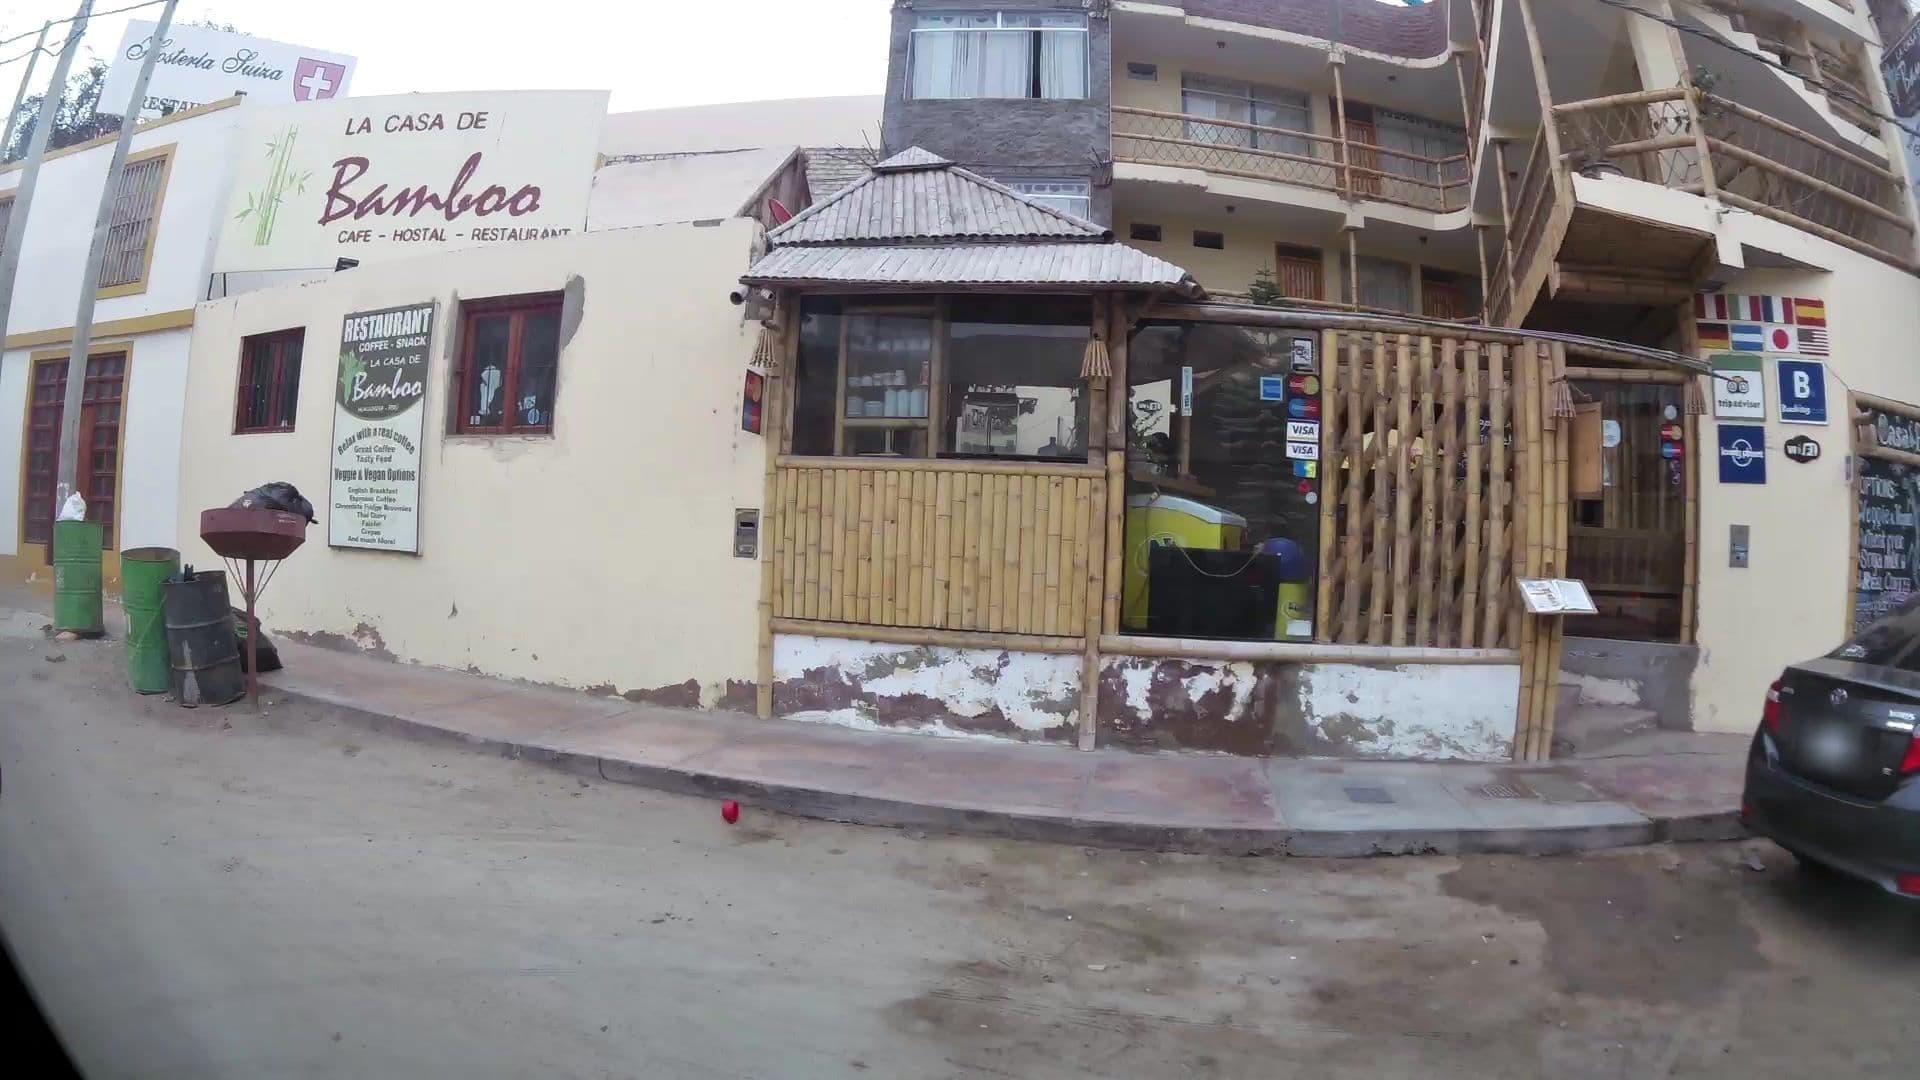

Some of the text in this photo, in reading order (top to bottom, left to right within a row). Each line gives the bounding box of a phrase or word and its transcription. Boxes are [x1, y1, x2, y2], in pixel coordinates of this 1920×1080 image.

[222, 48, 283, 81] Suiza
[345, 112, 489, 136] LA CASA DE
[318, 152, 541, 226] Bamboo
[338, 229, 372, 243] CAFE
[393, 228, 447, 242] HOSTAL
[344, 308, 433, 343] RESTAURANT
[359, 340, 389, 352] COFFEE
[396, 336, 427, 349] SNACK
[370, 354, 421, 368] LA CASA DE
[352, 368, 422, 402] Bamboo
[1793, 371, 1810, 398] B
[1292, 425, 1314, 436] VISA
[1292, 445, 1313, 455] VISA
[364, 468, 386, 482] Vegan
